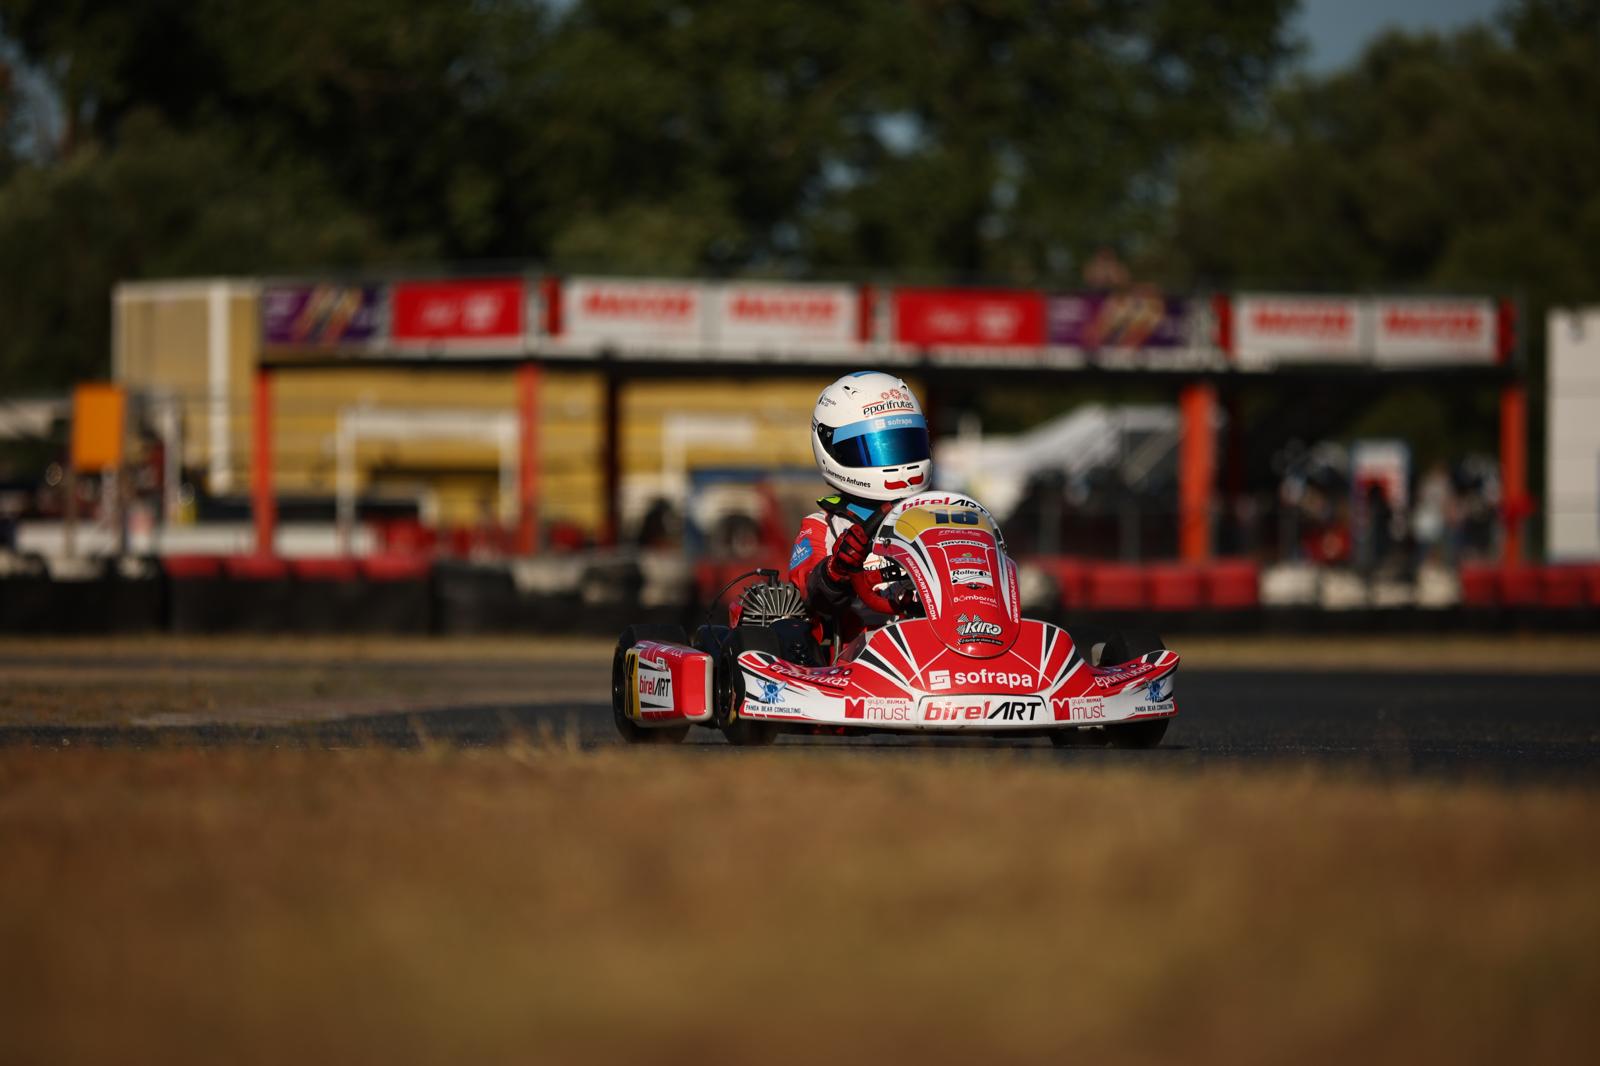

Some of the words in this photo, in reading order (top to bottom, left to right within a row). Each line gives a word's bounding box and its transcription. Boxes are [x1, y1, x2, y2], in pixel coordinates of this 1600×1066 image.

[863, 400, 914, 415] eporifrutas
[887, 417, 913, 426] sofrapa
[825, 467, 846, 482] Lourenço
[846, 476, 871, 488] Antunes
[964, 622, 1002, 635] KIRO
[955, 669, 1033, 688] sofrapa
[867, 705, 910, 720] must
[924, 701, 1042, 720] birelART
[1071, 702, 1105, 720] must
